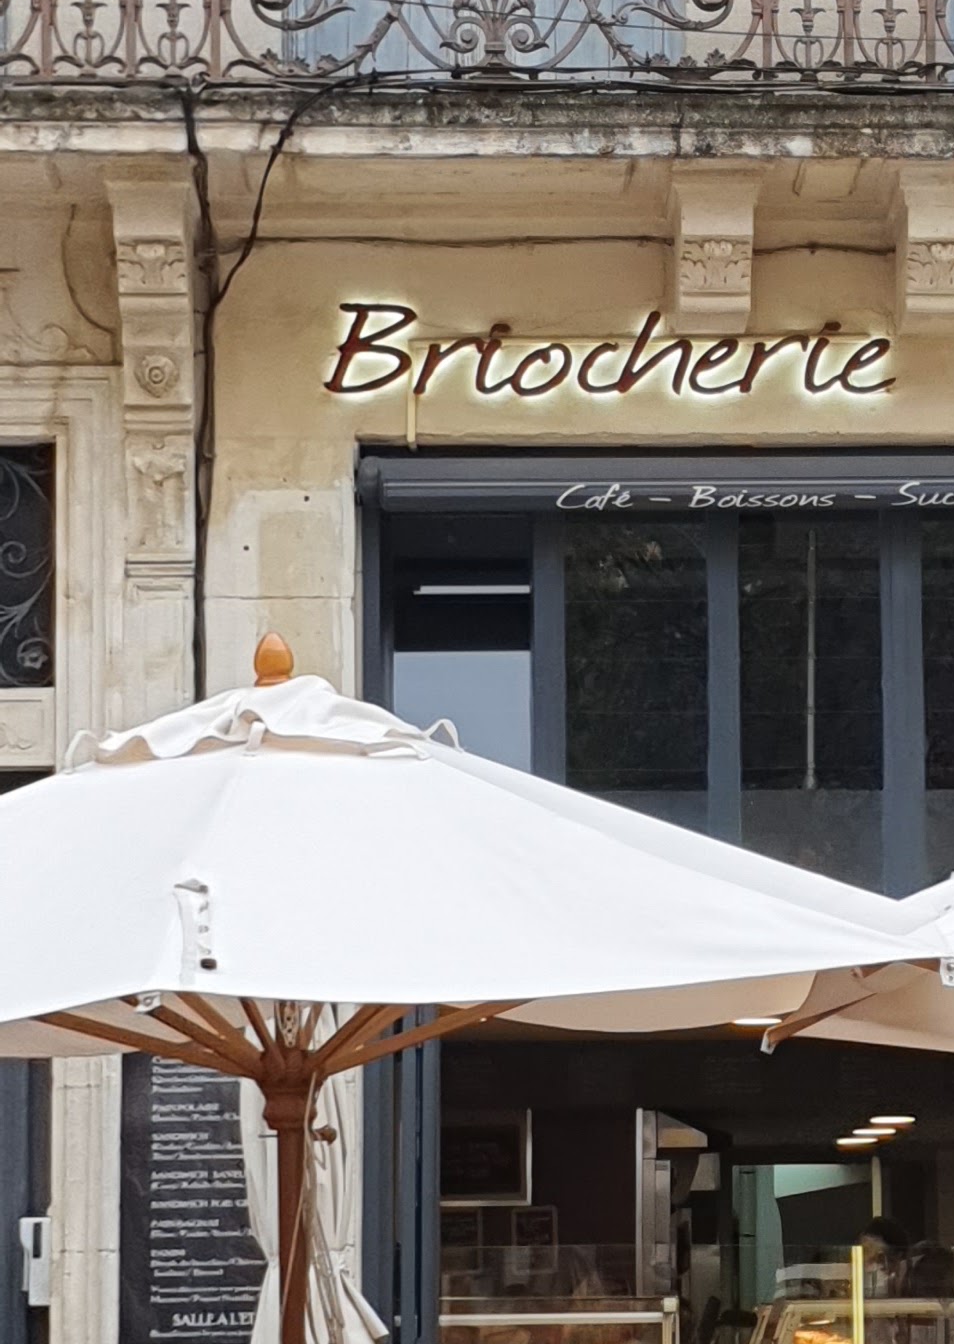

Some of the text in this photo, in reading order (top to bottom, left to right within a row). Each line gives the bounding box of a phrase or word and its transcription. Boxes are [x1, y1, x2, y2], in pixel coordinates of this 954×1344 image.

[324, 303, 896, 396] Briocherie
[556, 483, 634, 510] Café
[687, 485, 837, 508] Boissons
